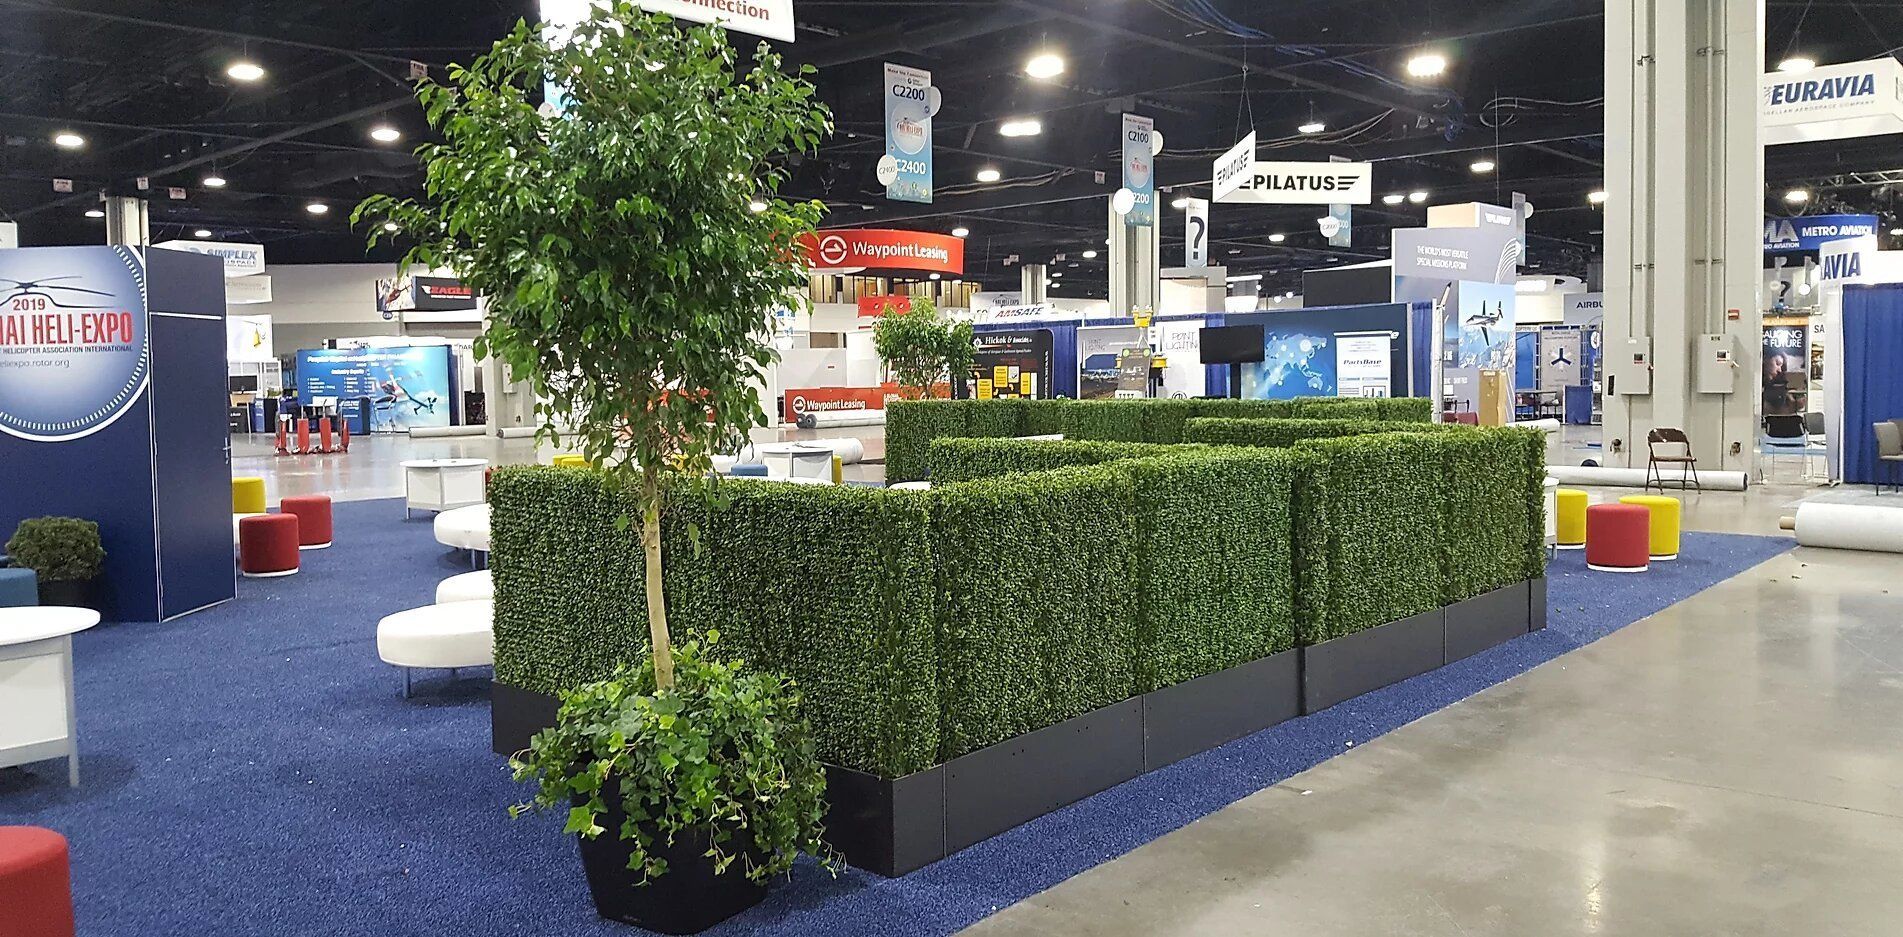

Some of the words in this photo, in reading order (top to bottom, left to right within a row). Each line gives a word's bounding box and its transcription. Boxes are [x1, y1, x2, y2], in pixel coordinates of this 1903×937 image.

[892, 84, 925, 101] C2200
[1771, 74, 1875, 106] EURAVIA
[1128, 131, 1149, 143] C2100
[896, 159, 926, 175] C2400
[1222, 155, 1245, 182] PILATUS
[1253, 174, 1335, 191] PILATUS
[1802, 226, 1838, 237] METRO
[852, 241, 914, 259] Waypoint
[914, 243, 948, 264] Leasing
[430, 286, 472, 295] EAGLE
[13, 299, 46, 311] 2019
[995, 306, 1045, 319] AMSAFE
[31, 312, 133, 344] HELI-EXPO
[985, 336, 1007, 345] Hickok
[2, 347, 41, 355] HELICOPTER
[42, 346, 84, 354] ASSOCIATION
[84, 345, 134, 353] INTERNATIONAL
[806, 399, 840, 412] Waypoint
[840, 398, 866, 411] Leasing
